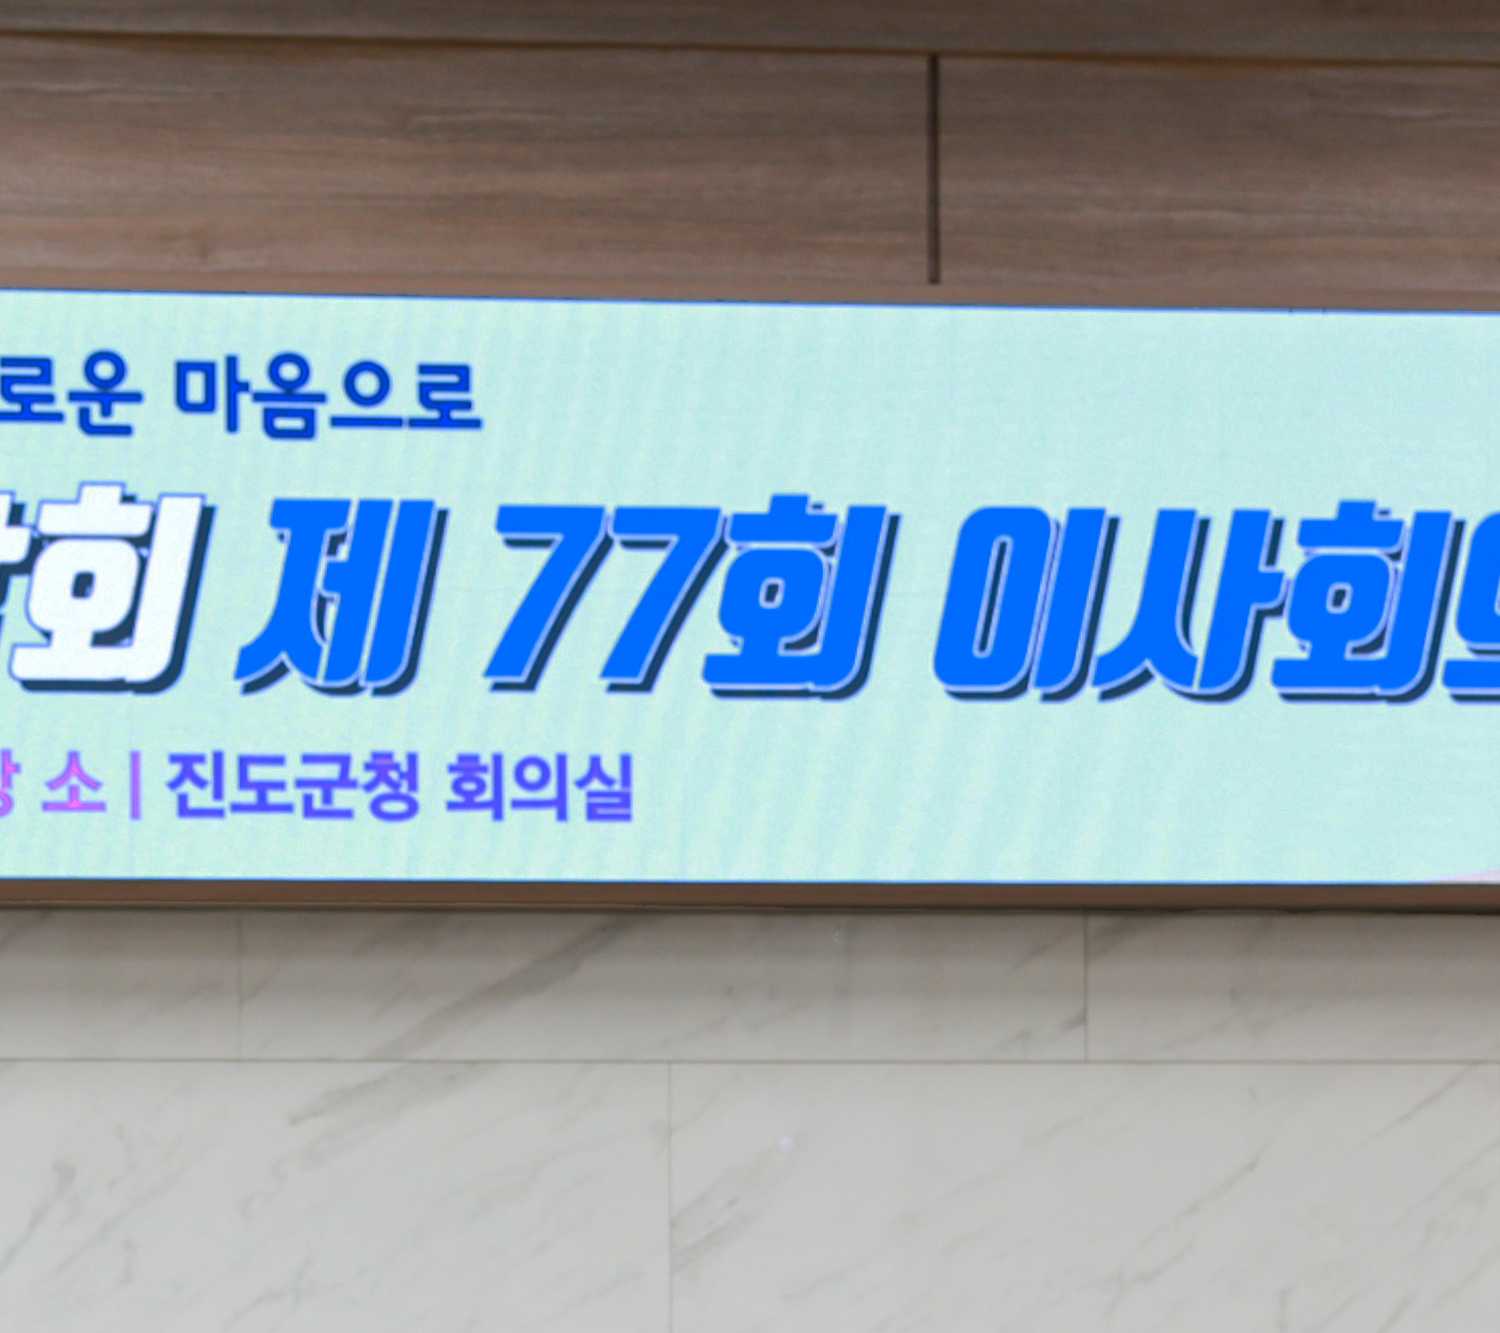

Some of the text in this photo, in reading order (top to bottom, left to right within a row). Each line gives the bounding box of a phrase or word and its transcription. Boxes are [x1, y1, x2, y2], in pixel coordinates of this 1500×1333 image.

[174, 352, 483, 440] 마음으로
[234, 497, 450, 695] 제
[484, 493, 902, 701] 77회
[165, 749, 420, 823] 진도군청
[444, 751, 634, 823] 회의실
